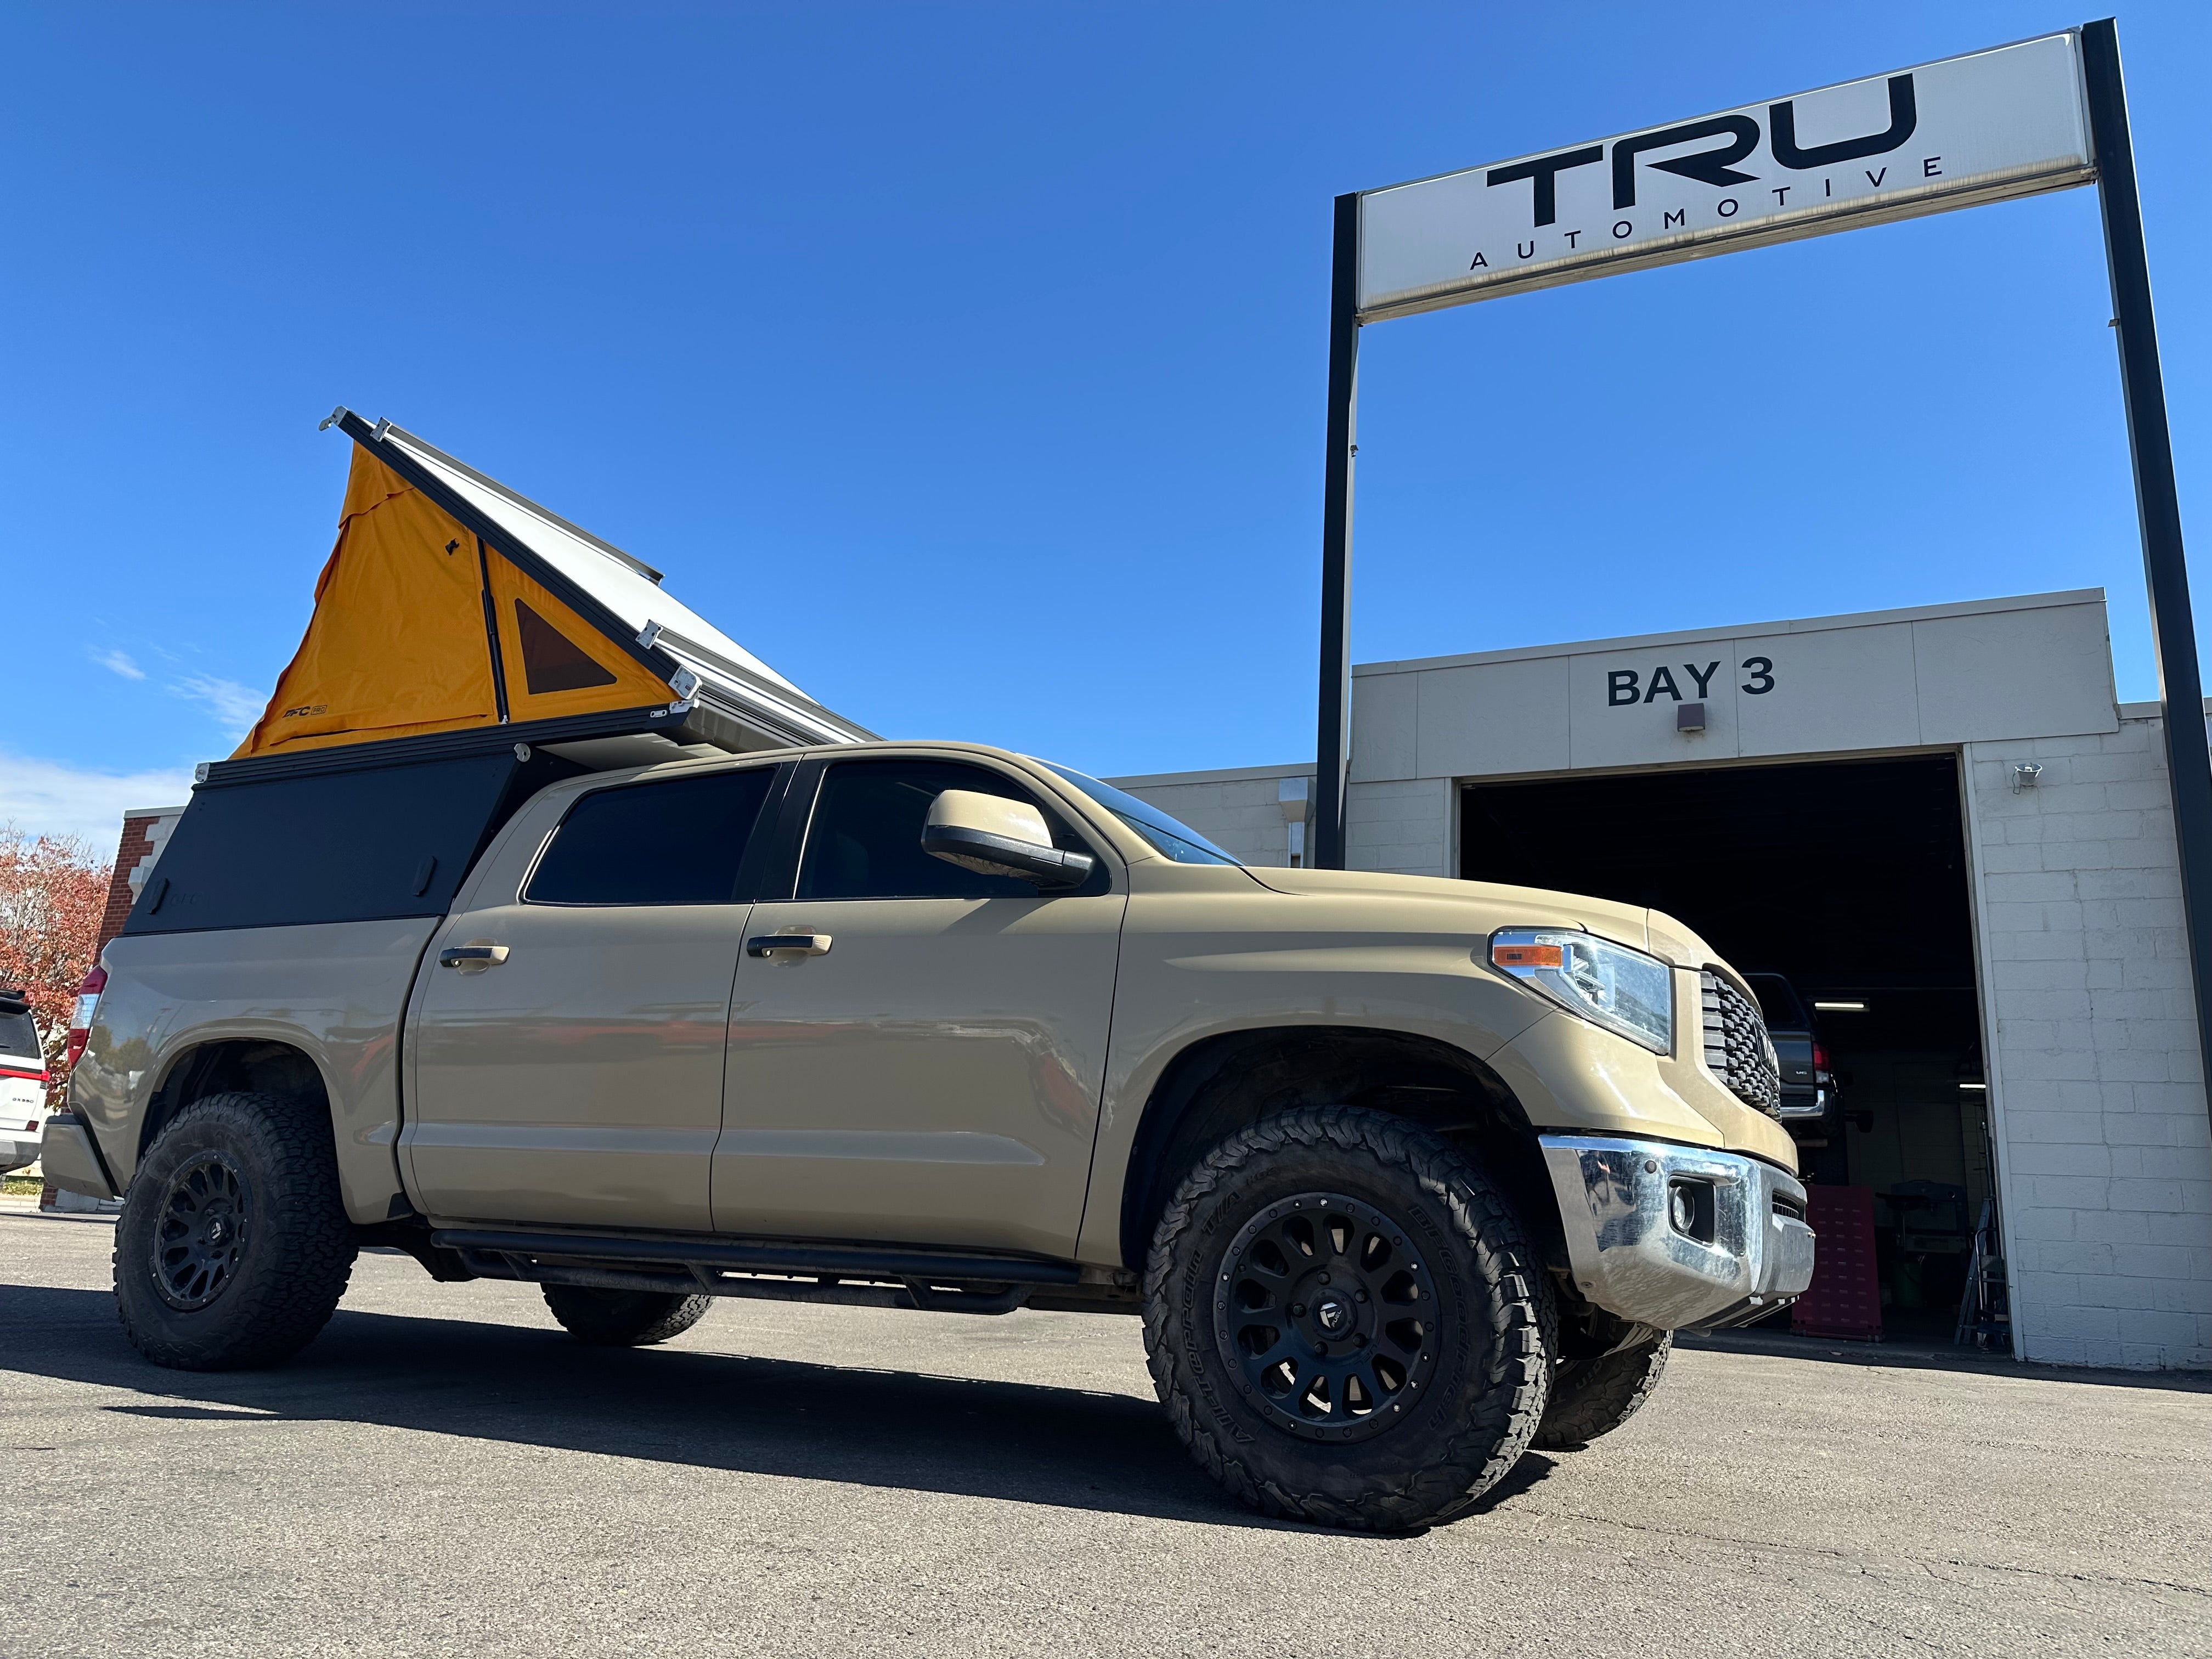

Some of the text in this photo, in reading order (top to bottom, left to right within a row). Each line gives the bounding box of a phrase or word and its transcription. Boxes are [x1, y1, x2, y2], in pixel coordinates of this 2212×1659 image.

[1487, 73, 1916, 227] TRU
[1470, 157, 1942, 270] AUTOMOTIVE
[1608, 657, 1775, 706] BAY 3
[1201, 1190, 1242, 1234] T/A
[1181, 1249, 1255, 1443] All-Terrain
[1331, 1310, 1342, 1328] FUEL
[1408, 1206, 1471, 1431] BFGoodrich
